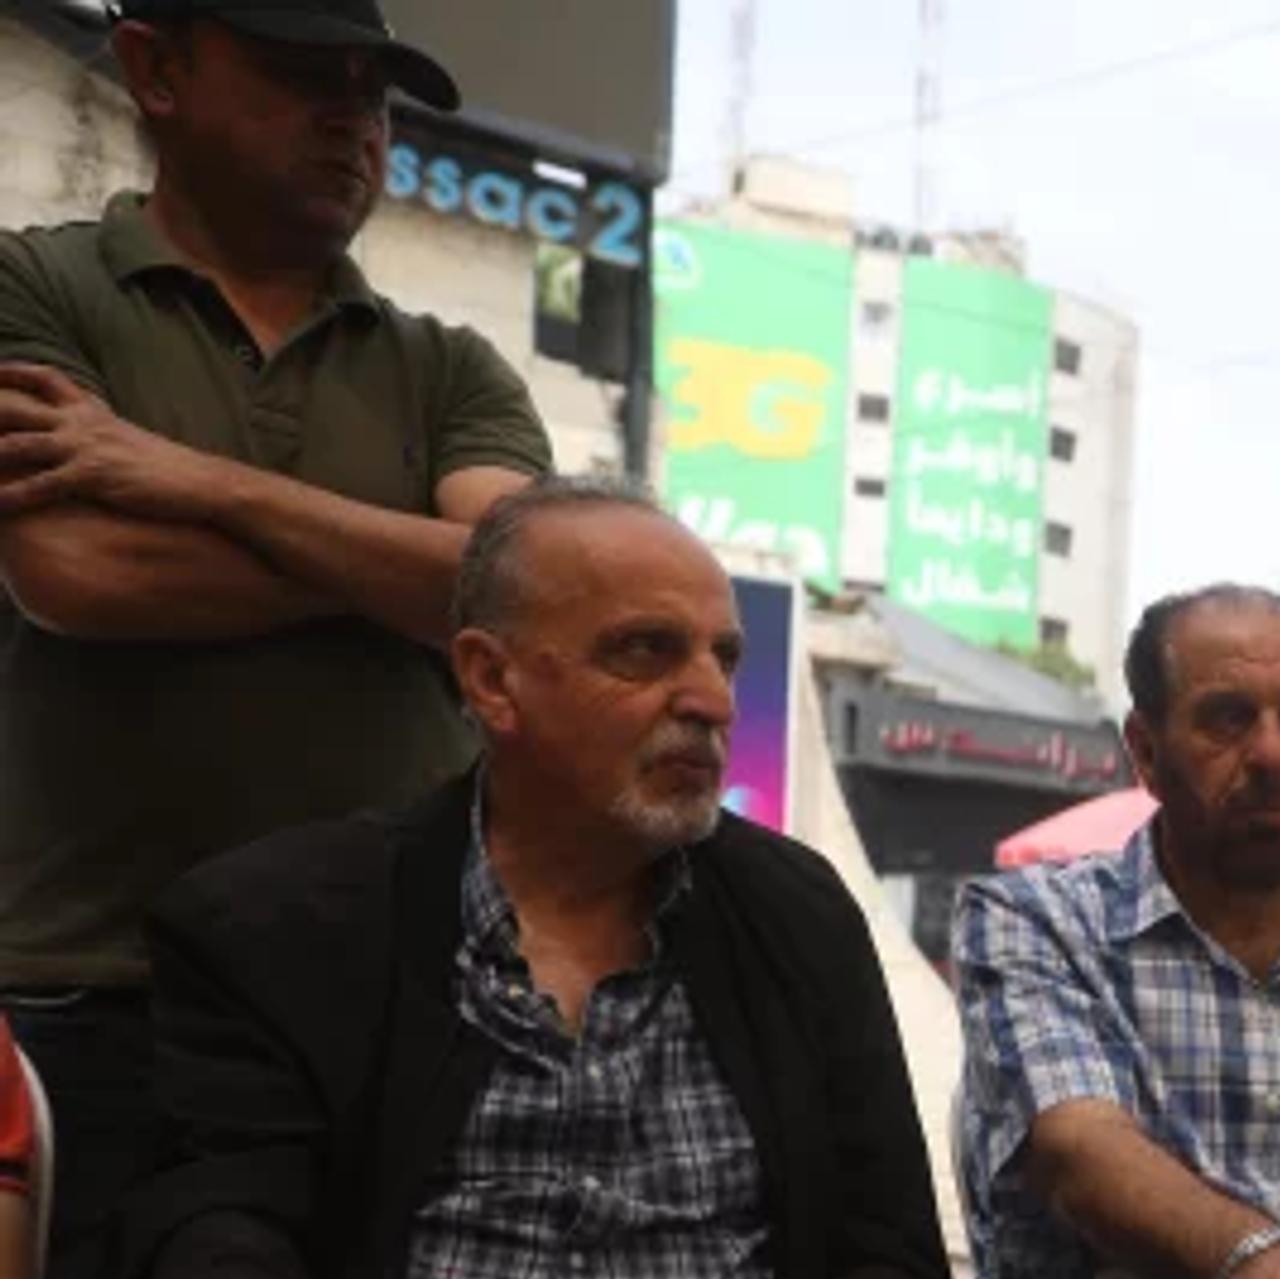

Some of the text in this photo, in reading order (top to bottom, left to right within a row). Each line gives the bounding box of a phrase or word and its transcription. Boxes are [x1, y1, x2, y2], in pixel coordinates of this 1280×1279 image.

[383, 143, 643, 267] ssac 2
[665, 334, 832, 462] 3G
